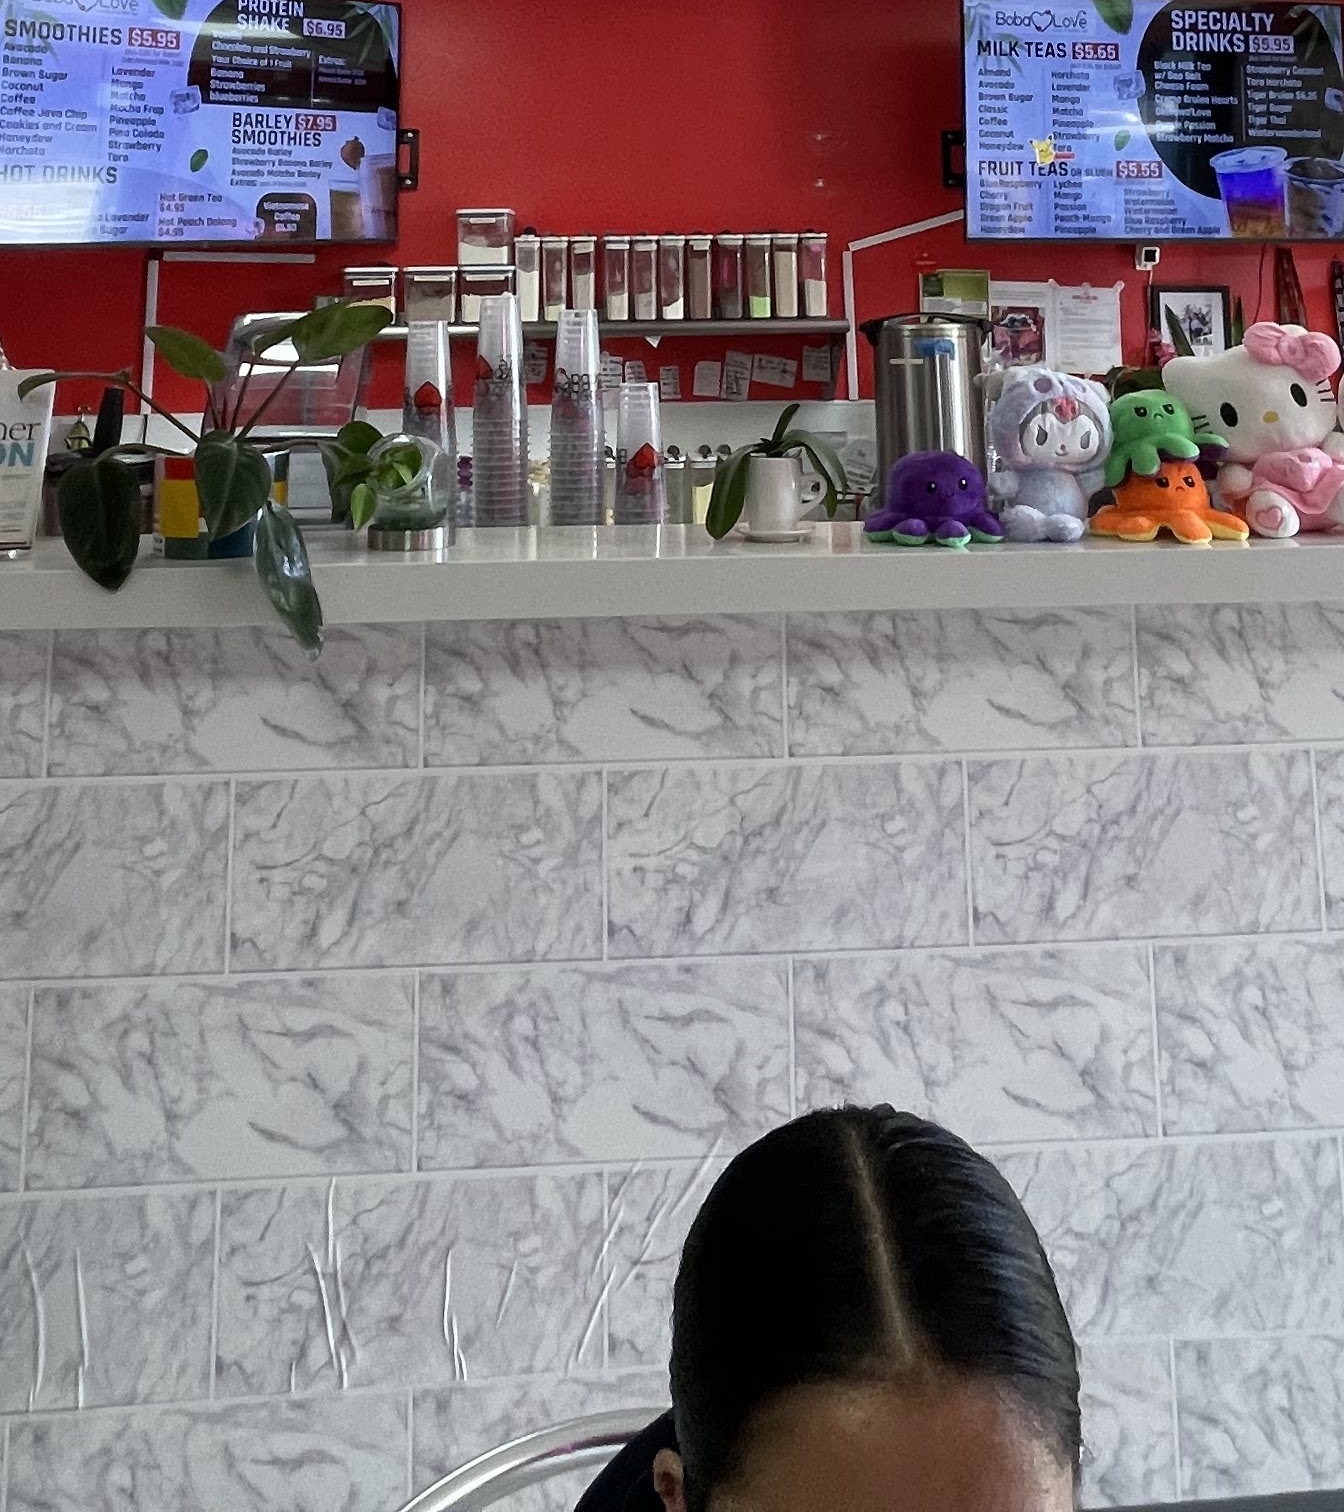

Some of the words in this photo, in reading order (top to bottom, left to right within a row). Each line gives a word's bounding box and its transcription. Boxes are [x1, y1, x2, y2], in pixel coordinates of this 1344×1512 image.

[995, 10, 1032, 26] Boba
[1053, 9, 1087, 28] Love
[1171, 9, 1275, 33] SPECIALTY
[237, 13, 290, 33] SHAKE
[306, 20, 344, 37] $6.95
[4, 18, 123, 46] SMOOTHIES
[130, 29, 177, 49] $5.95
[1172, 31, 1245, 53] DRINKS
[1251, 38, 1291, 51] $5.95
[977, 40, 1020, 58] MILK
[1024, 41, 1068, 58] TEAS
[3, 55, 43, 66] Banana
[2, 67, 35, 78] Brown
[38, 69, 69, 82] Sugar
[111, 65, 155, 78] Lavender
[978, 67, 1011, 77] Almond
[1, 80, 44, 92] Coconut
[978, 80, 1015, 89] Avocado
[1, 93, 36, 104] Coffee
[978, 92, 1006, 101] Brown
[0, 105, 35, 117] Coffee
[38, 109, 63, 118] Java
[65, 109, 88, 120] Chip
[978, 105, 1008, 113] Classic
[0, 119, 40, 131] Cookies
[43, 122, 62, 131] and
[109, 115, 157, 127] Pineapple
[232, 112, 292, 129] BARLEY
[296, 115, 333, 130] $7.95
[979, 117, 1008, 126] Coffee
[0, 133, 53, 144] Honeydew
[132, 128, 165, 139] Colada
[231, 129, 322, 147] SMOOTHIES
[979, 129, 1015, 138] Coconut
[108, 141, 162, 153] Strawberry
[979, 142, 1025, 152] Honeydew
[42, 165, 118, 184] DRINKS
[978, 160, 1024, 176] FRUIT
[1028, 160, 1069, 177] TEAS
[159, 194, 174, 203] Hot
[175, 194, 205, 203] Green
[207, 194, 222, 203] Tea
[980, 191, 1008, 200] Cherry
[1054, 202, 1087, 212] Passion
[105, 213, 150, 223] Lavender
[158, 217, 174, 227] Hot
[177, 217, 204, 227] Peach
